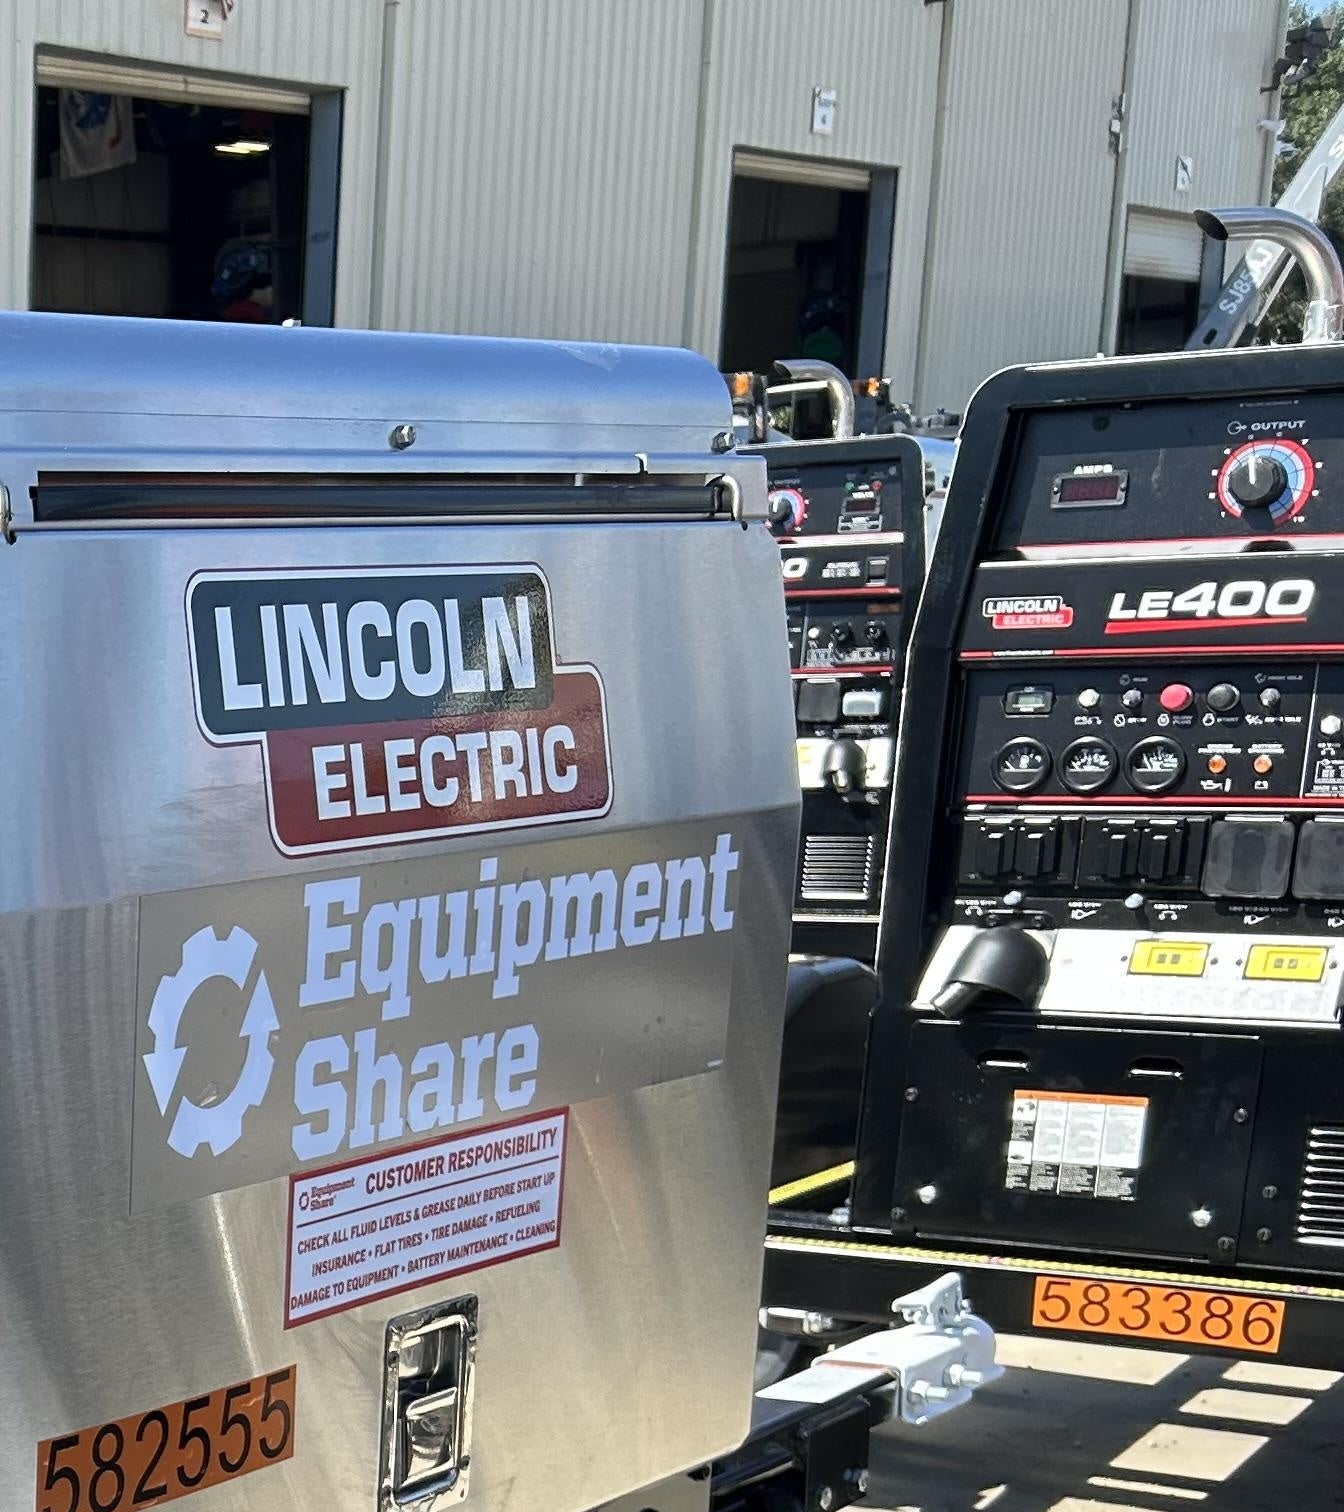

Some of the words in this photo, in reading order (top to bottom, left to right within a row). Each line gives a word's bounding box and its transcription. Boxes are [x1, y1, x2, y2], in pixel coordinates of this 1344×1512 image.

[200, 9, 209, 24] 2
[1251, 420, 1306, 431] OUTPUT
[987, 600, 1057, 613] LINCOLN
[1003, 614, 1065, 624] ELECTRIC
[1109, 580, 1315, 620] LE400
[214, 594, 537, 712] LINCOLN
[314, 723, 578, 822] ELECTRIC
[298, 833, 740, 1023] Equipment
[291, 1022, 539, 1162] Share
[311, 1177, 355, 1198] Equipment
[366, 1158, 444, 1194] CUSTOMER
[448, 1127, 557, 1172] RESPONSIBILITY
[297, 1233, 329, 1255] CHECK
[331, 1228, 348, 1246] ALL
[351, 1219, 377, 1240] FLUID
[379, 1211, 412, 1232] LEVELS
[413, 1209, 420, 1220] &
[422, 1199, 456, 1219] GREASE
[457, 1191, 482, 1210] DAILY
[483, 1183, 515, 1202] BEFORE
[516, 1176, 541, 1195] START
[543, 1172, 556, 1187] UP
[312, 1249, 366, 1278] INSURANCE
[375, 1241, 396, 1259] FLAT
[398, 1233, 422, 1252] TIRES
[431, 1226, 450, 1242] TIRE
[452, 1214, 487, 1236] DAMAGE
[495, 1200, 541, 1224] REFUELING
[290, 1285, 330, 1310] DAMAGE
[332, 1281, 344, 1297] TO
[346, 1264, 399, 1292] EQUIPMENT
[407, 1251, 445, 1274] BATTERY
[447, 1233, 508, 1265] MAINTENANCE
[515, 1220, 556, 1242] CLEANING
[1038, 1280, 1279, 1347] 583386
